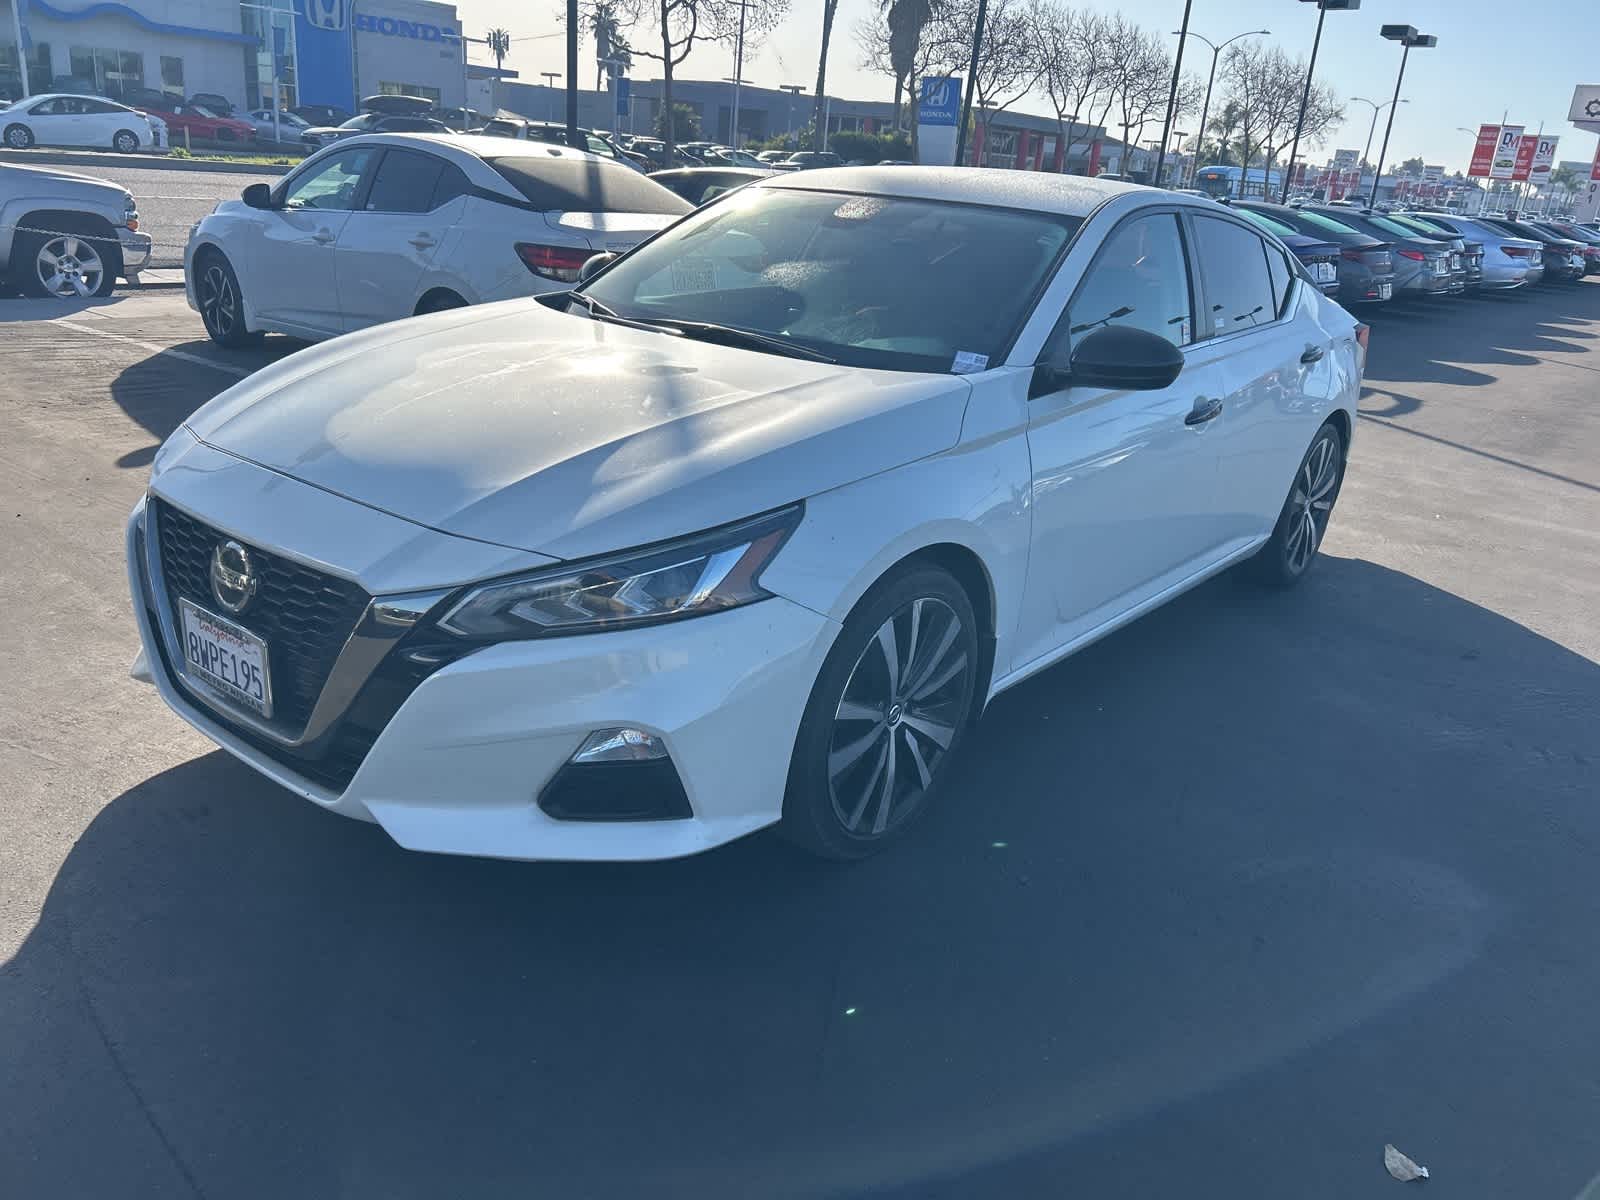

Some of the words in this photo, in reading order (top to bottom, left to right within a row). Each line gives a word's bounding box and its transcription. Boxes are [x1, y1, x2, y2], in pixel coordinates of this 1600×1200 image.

[356, 14, 461, 46] HONDA
[920, 111, 953, 120] HONDA
[215, 566, 250, 590] NISSAN
[189, 631, 264, 700] 8WPE195
